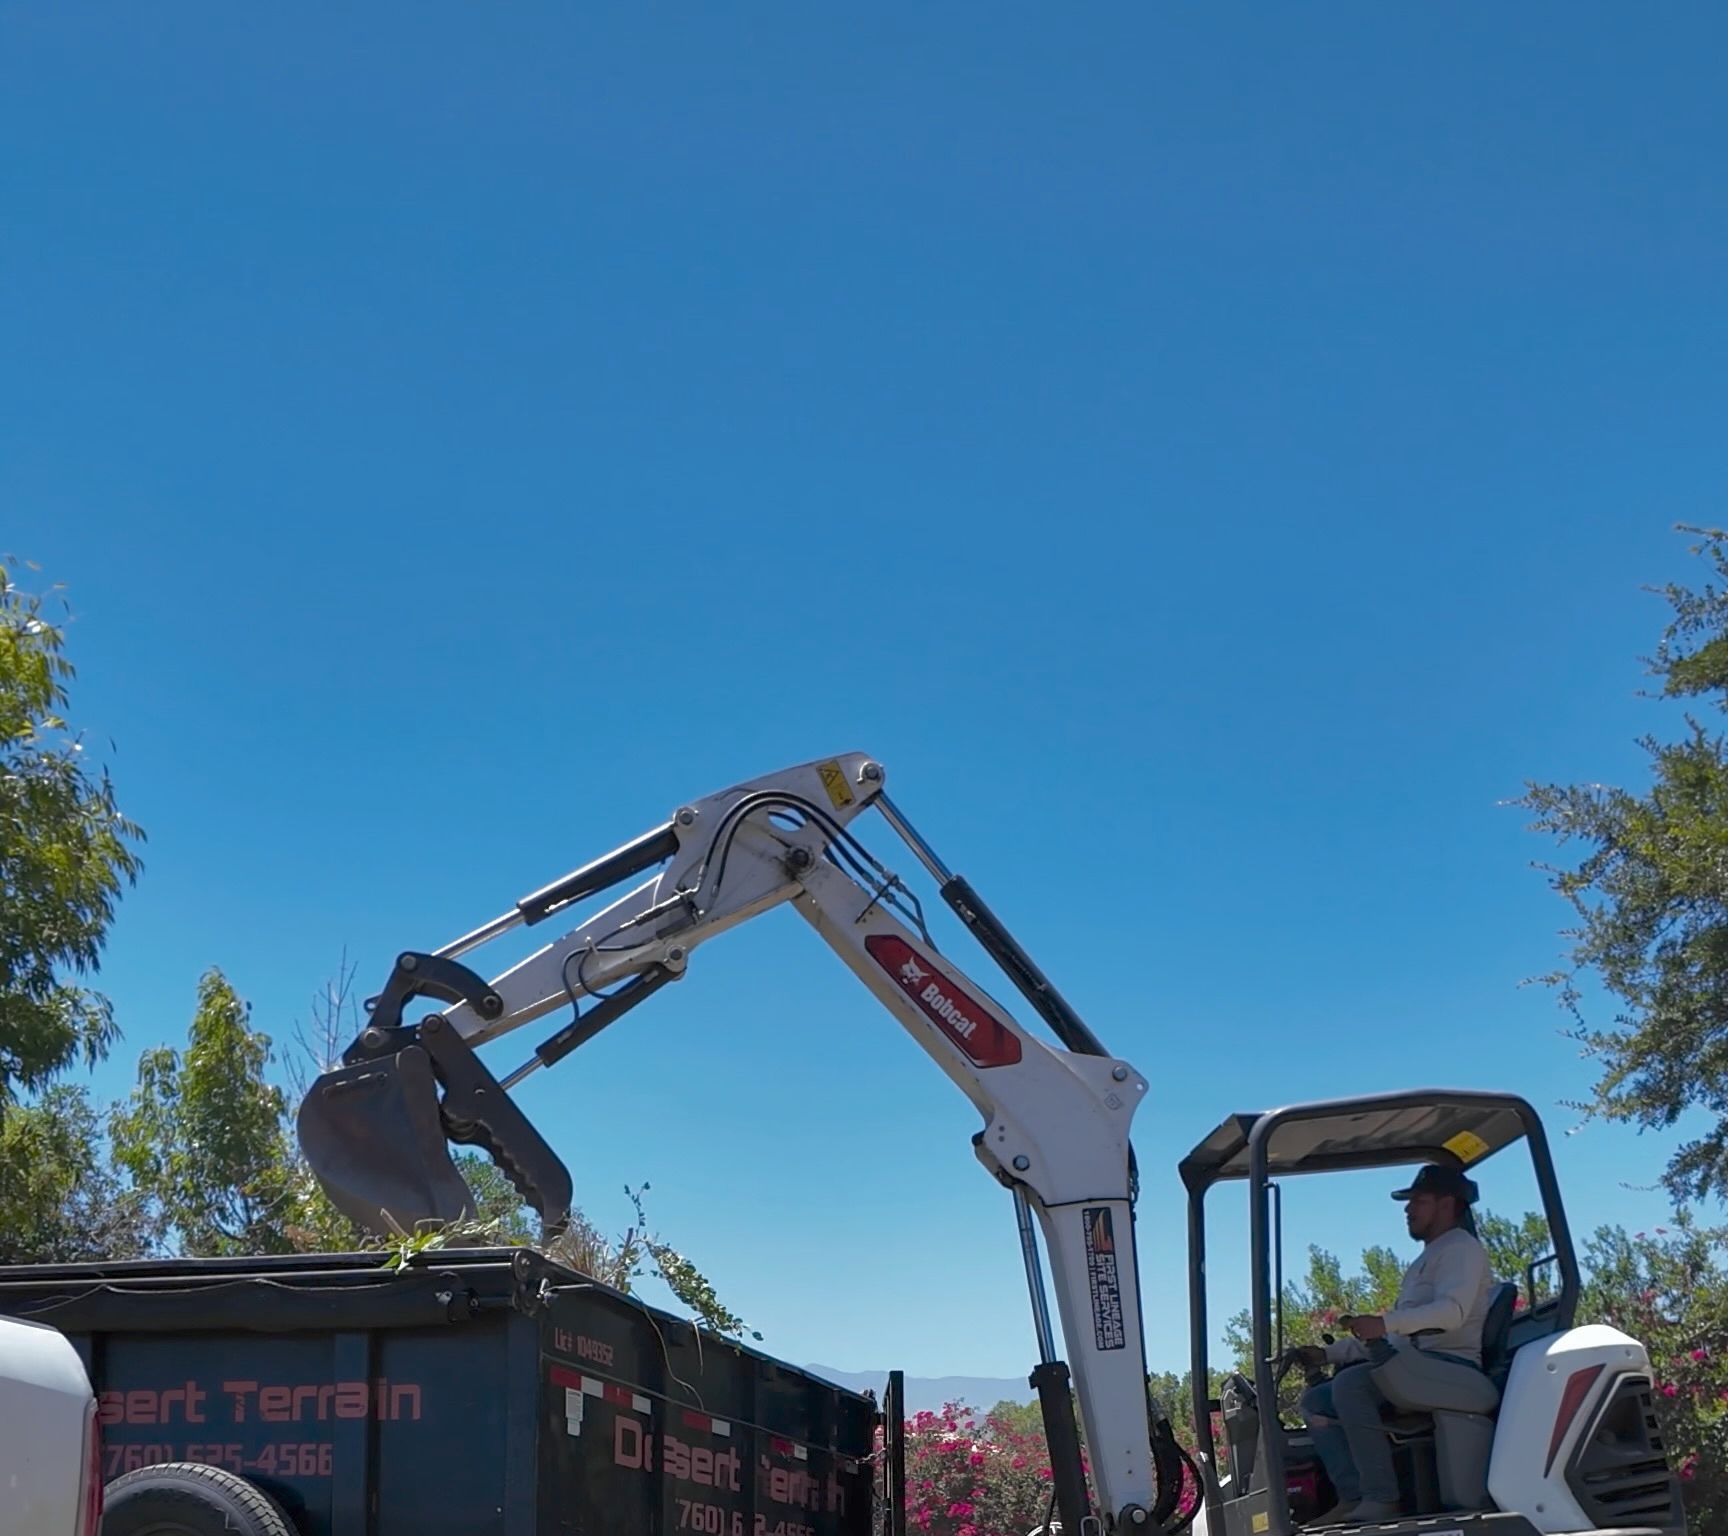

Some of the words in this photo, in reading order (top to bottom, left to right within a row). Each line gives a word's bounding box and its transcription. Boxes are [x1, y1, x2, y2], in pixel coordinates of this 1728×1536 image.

[920, 983, 977, 1039] Bobcat
[1096, 1254, 1108, 1281] SITE
[1104, 1254, 1118, 1291] FIRST
[1099, 1284, 1115, 1348] SERVICES
[1110, 1294, 1124, 1345] LINEAGE
[223, 1377, 421, 1424] Terrain
